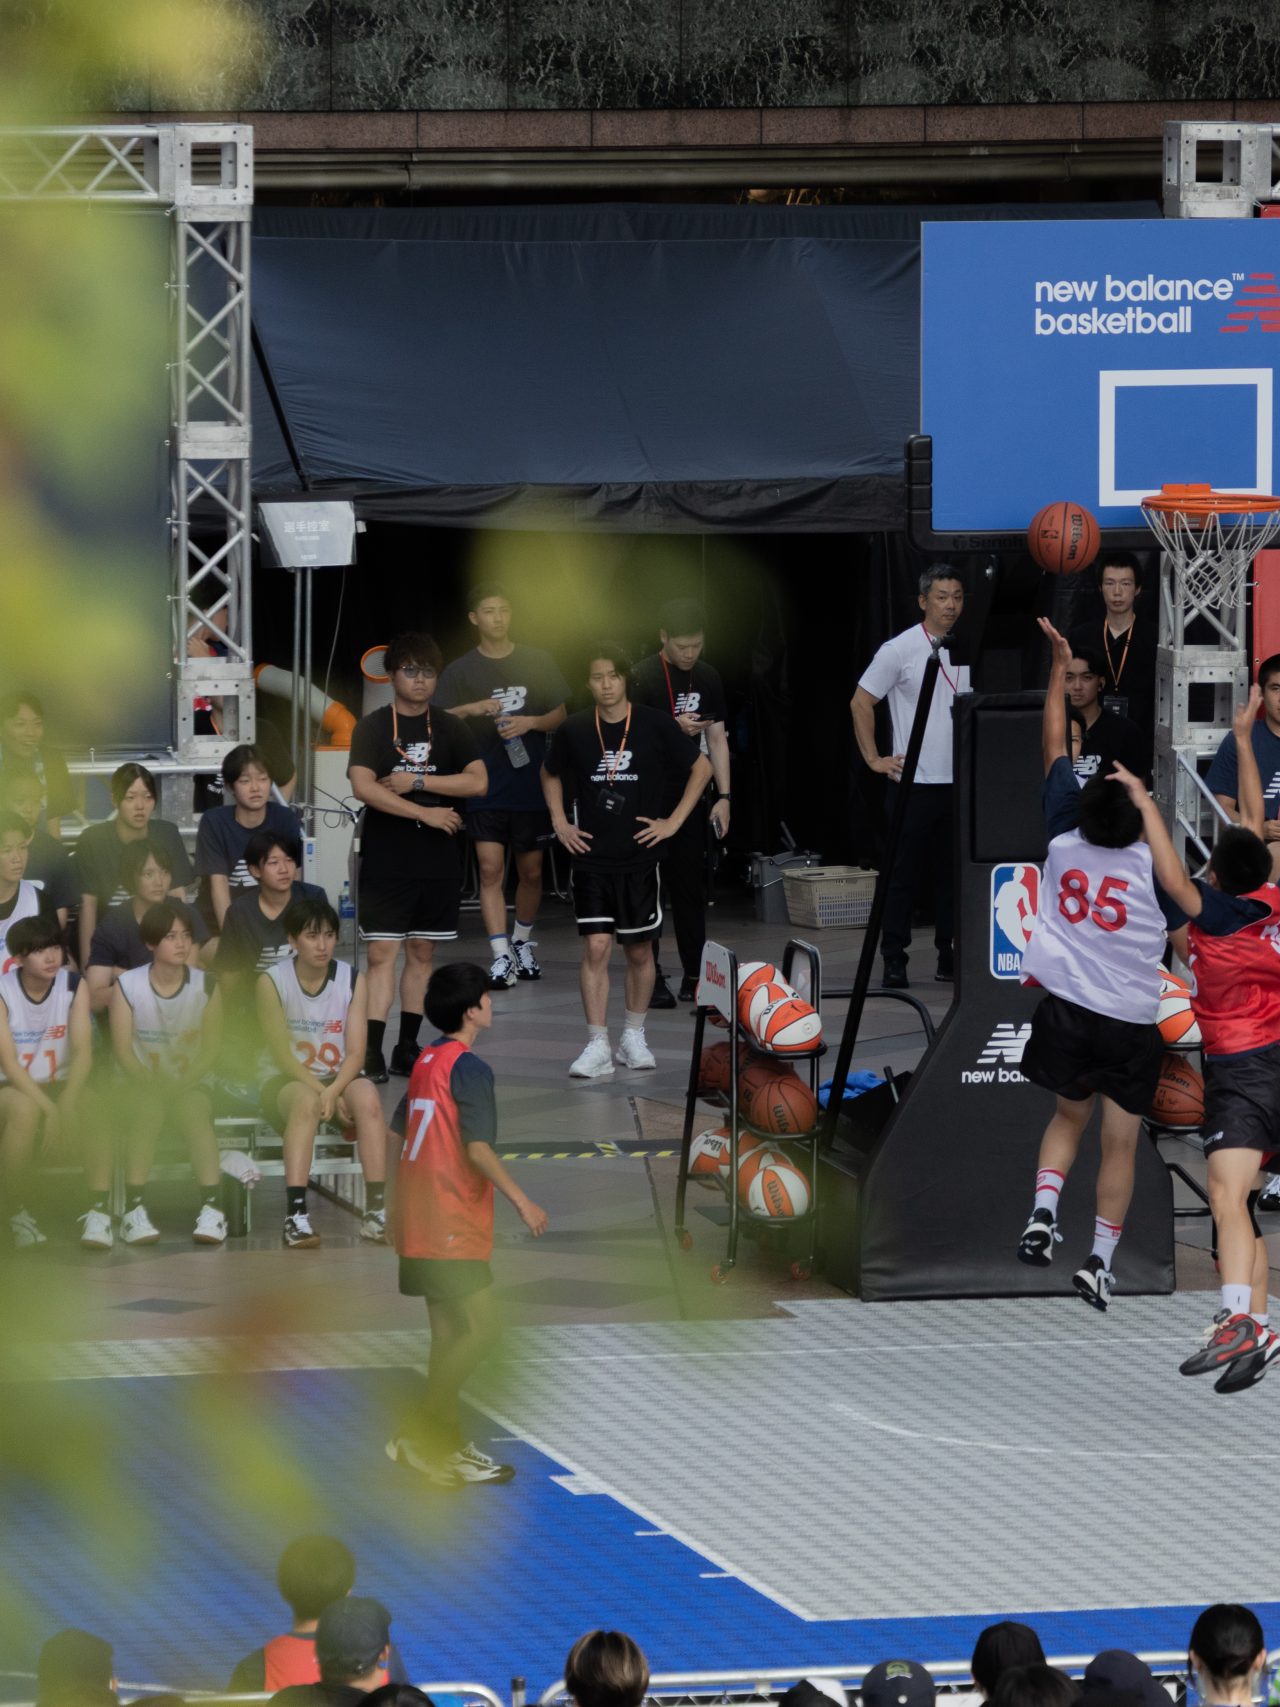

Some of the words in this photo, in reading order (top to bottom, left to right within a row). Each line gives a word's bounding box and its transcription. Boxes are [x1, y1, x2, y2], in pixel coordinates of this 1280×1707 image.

[1035, 280, 1098, 302] new
[1035, 306, 1192, 335] basketball
[1058, 869, 1129, 932] 85
[706, 960, 726, 989] Wilson
[998, 953, 1021, 972] NBA
[962, 1070, 995, 1084] new
[401, 1098, 435, 1162] 7
